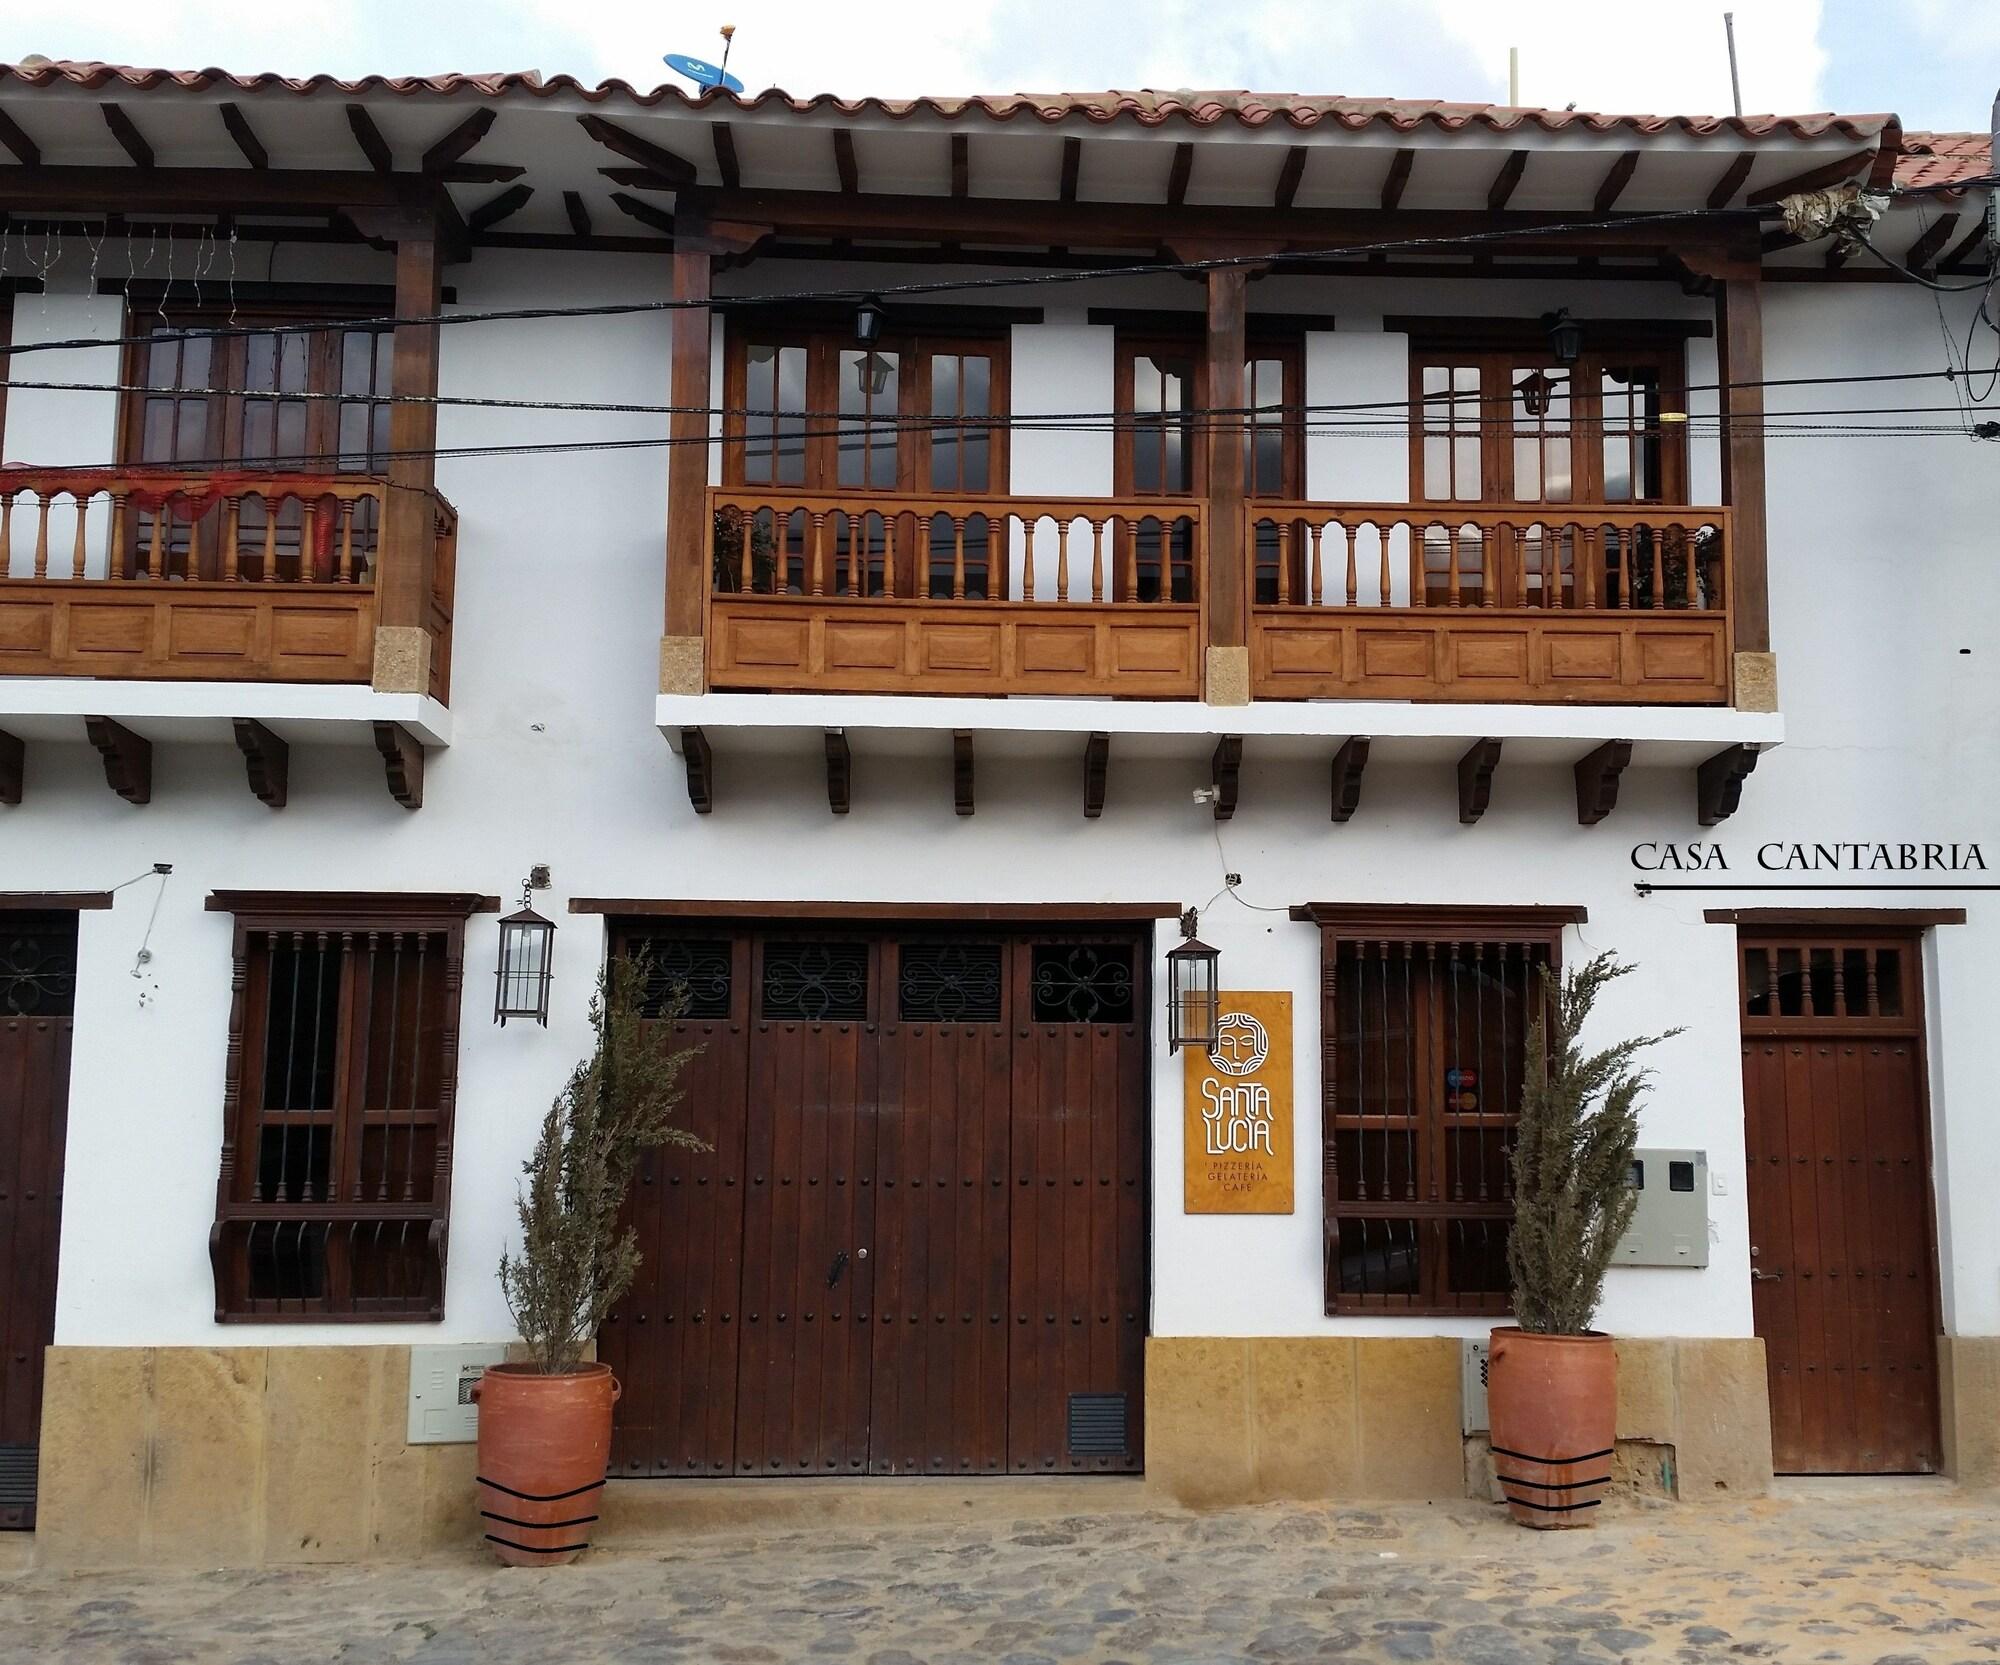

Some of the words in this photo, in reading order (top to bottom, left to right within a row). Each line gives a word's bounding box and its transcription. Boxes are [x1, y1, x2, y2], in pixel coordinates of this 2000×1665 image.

[1630, 841, 1731, 872] CASA
[1756, 841, 1989, 871] CANTABRIA
[1201, 1077, 1274, 1120] SANTA
